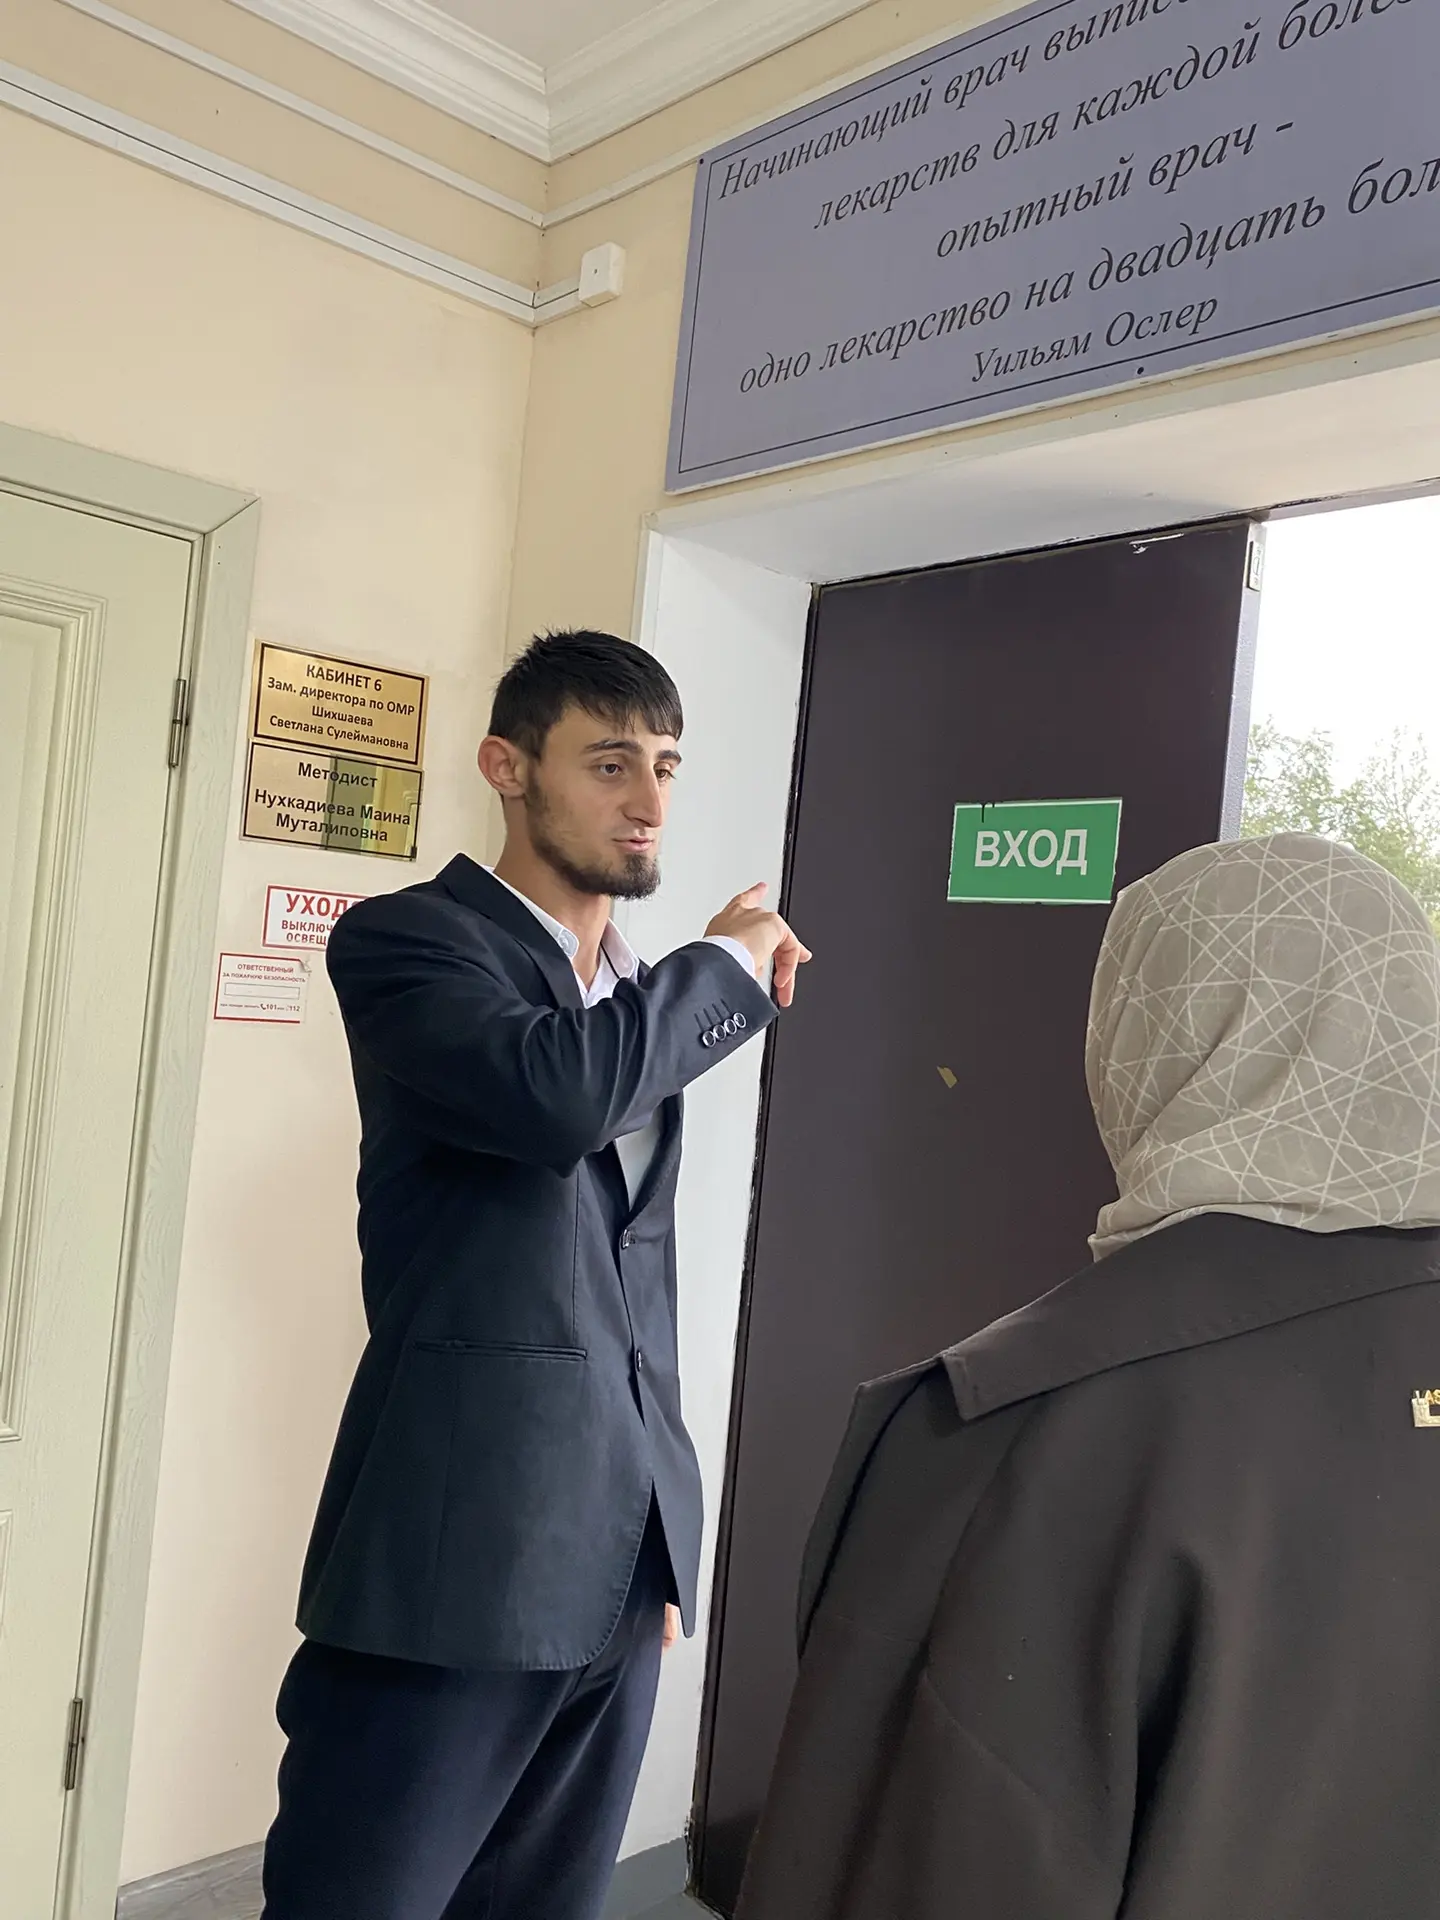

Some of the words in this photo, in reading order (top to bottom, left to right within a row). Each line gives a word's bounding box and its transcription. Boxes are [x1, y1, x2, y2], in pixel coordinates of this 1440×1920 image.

[718, 78, 932, 199] Начинающий
[943, 44, 1030, 110] врач
[1043, 0, 1189, 61] выпи
[814, 144, 981, 230] лекарств
[993, 111, 1060, 160] для
[1073, 17, 1261, 131] каждой
[1278, 0, 1412, 50] бол
[937, 153, 1135, 257] опытный
[1148, 122, 1257, 195] врач
[740, 351, 811, 393] одно
[819, 291, 1010, 371] лекарство
[1024, 269, 1075, 311] на
[1088, 196, 1326, 290] двадцать
[971, 331, 1092, 383] Уильям
[1105, 298, 1218, 347] Ослер
[306, 664, 371, 689] КАБИНЕТ
[374, 679, 382, 691] 6
[267, 677, 297, 693] Зам.
[300, 685, 366, 708] директора
[369, 700, 384, 710] по
[386, 701, 415, 716] ОМР
[270, 715, 324, 735] Светлана
[327, 726, 409, 750] Сулеймановна
[311, 705, 374, 727] Шихшаева
[298, 762, 378, 788] Методист
[254, 788, 355, 817] Нухкадиева
[360, 804, 411, 825] Маина
[276, 812, 388, 842] Муталиповна
[974, 829, 1088, 875] ВХОД
[286, 892, 361, 921] УХОД
[286, 932, 327, 946] ОСВЕЩ
[237, 964, 294, 974] ОТВЕТСТВЕННЫЙ
[264, 975, 305, 983] БЕЗОПАСНОСТЬ
